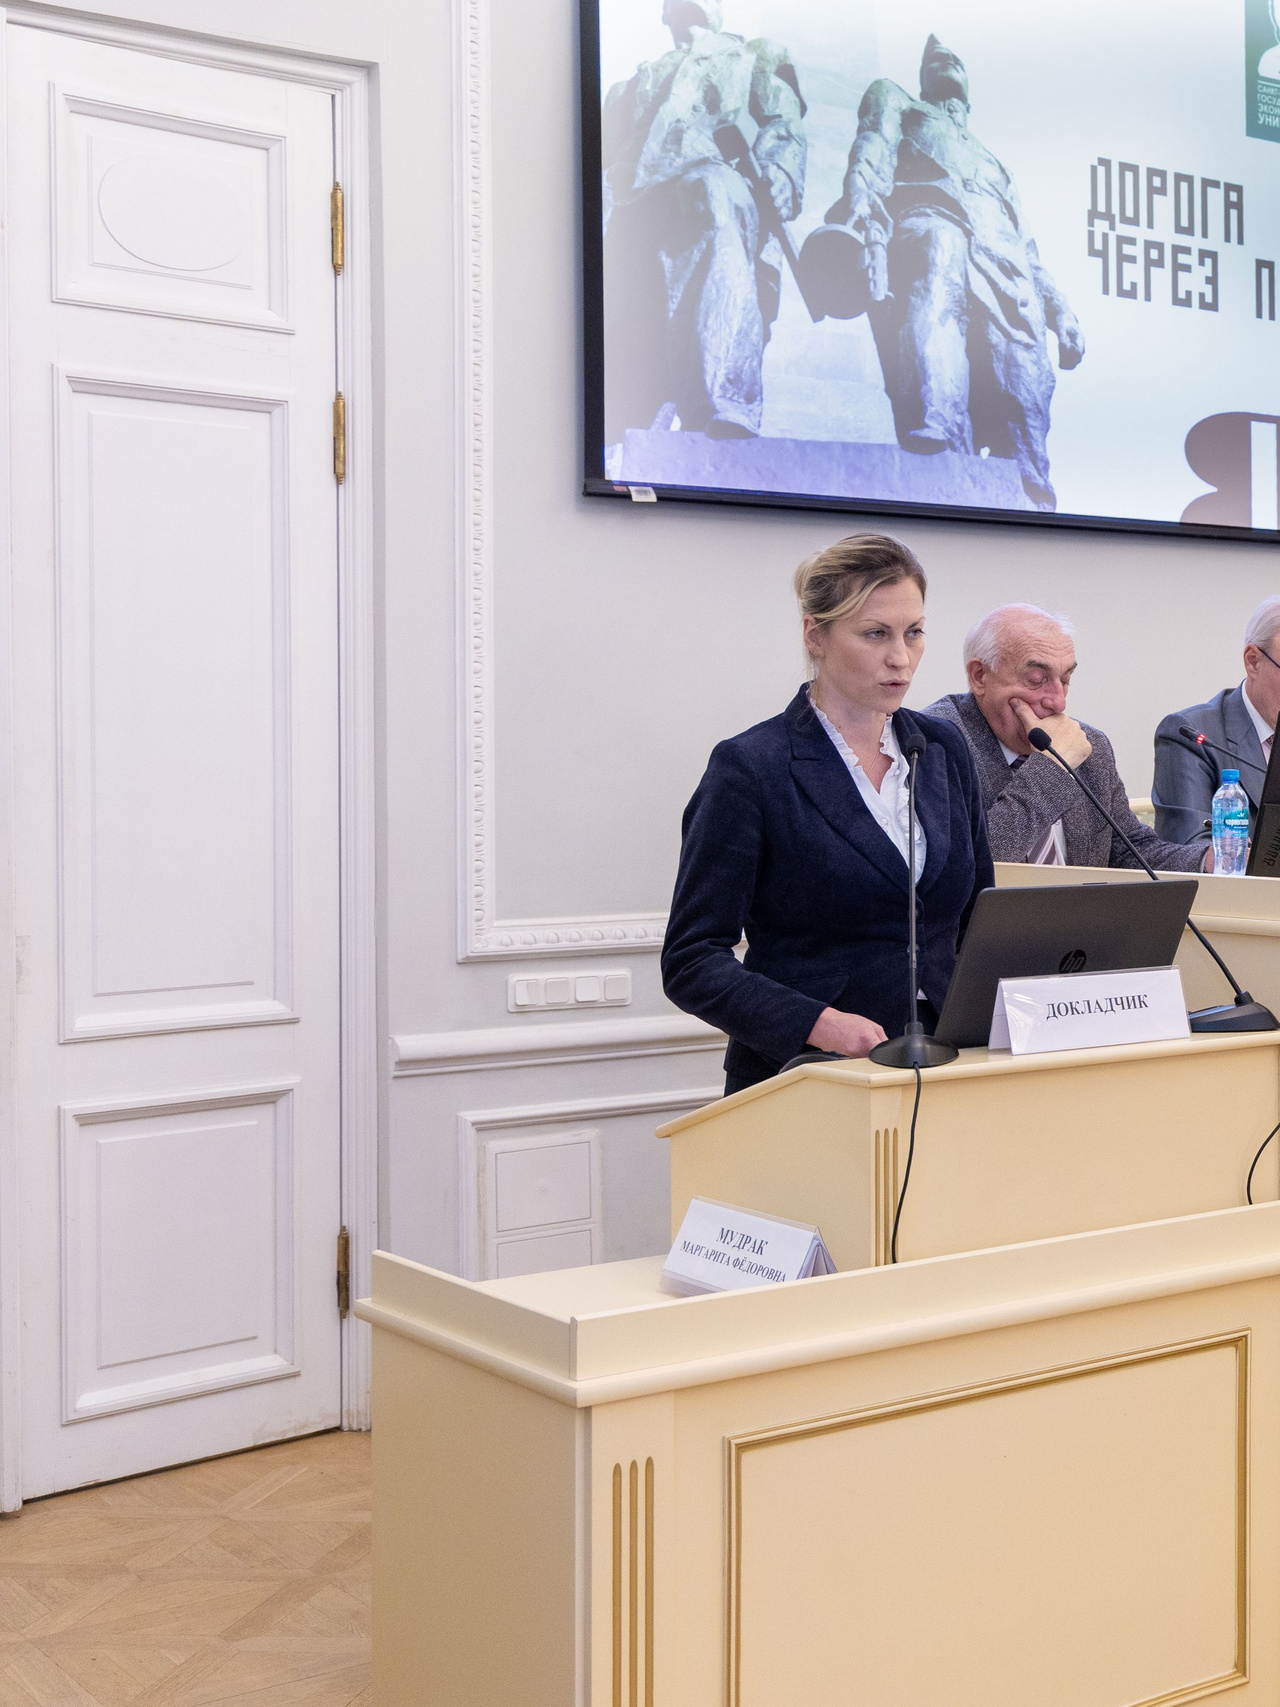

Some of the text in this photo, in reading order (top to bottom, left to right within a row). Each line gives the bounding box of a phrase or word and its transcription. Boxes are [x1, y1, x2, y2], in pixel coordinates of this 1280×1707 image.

[1087, 156, 1244, 246] ДОРОГА
[1087, 229, 1219, 312] ЧЕРЕЗ
[1061, 950, 1085, 973] hp
[1046, 993, 1149, 1021] ДОКЛАДЧИК
[716, 1227, 769, 1256] МУДРАК
[680, 1240, 787, 1283] МАРГАРИТА ФЁДОРОВНА
